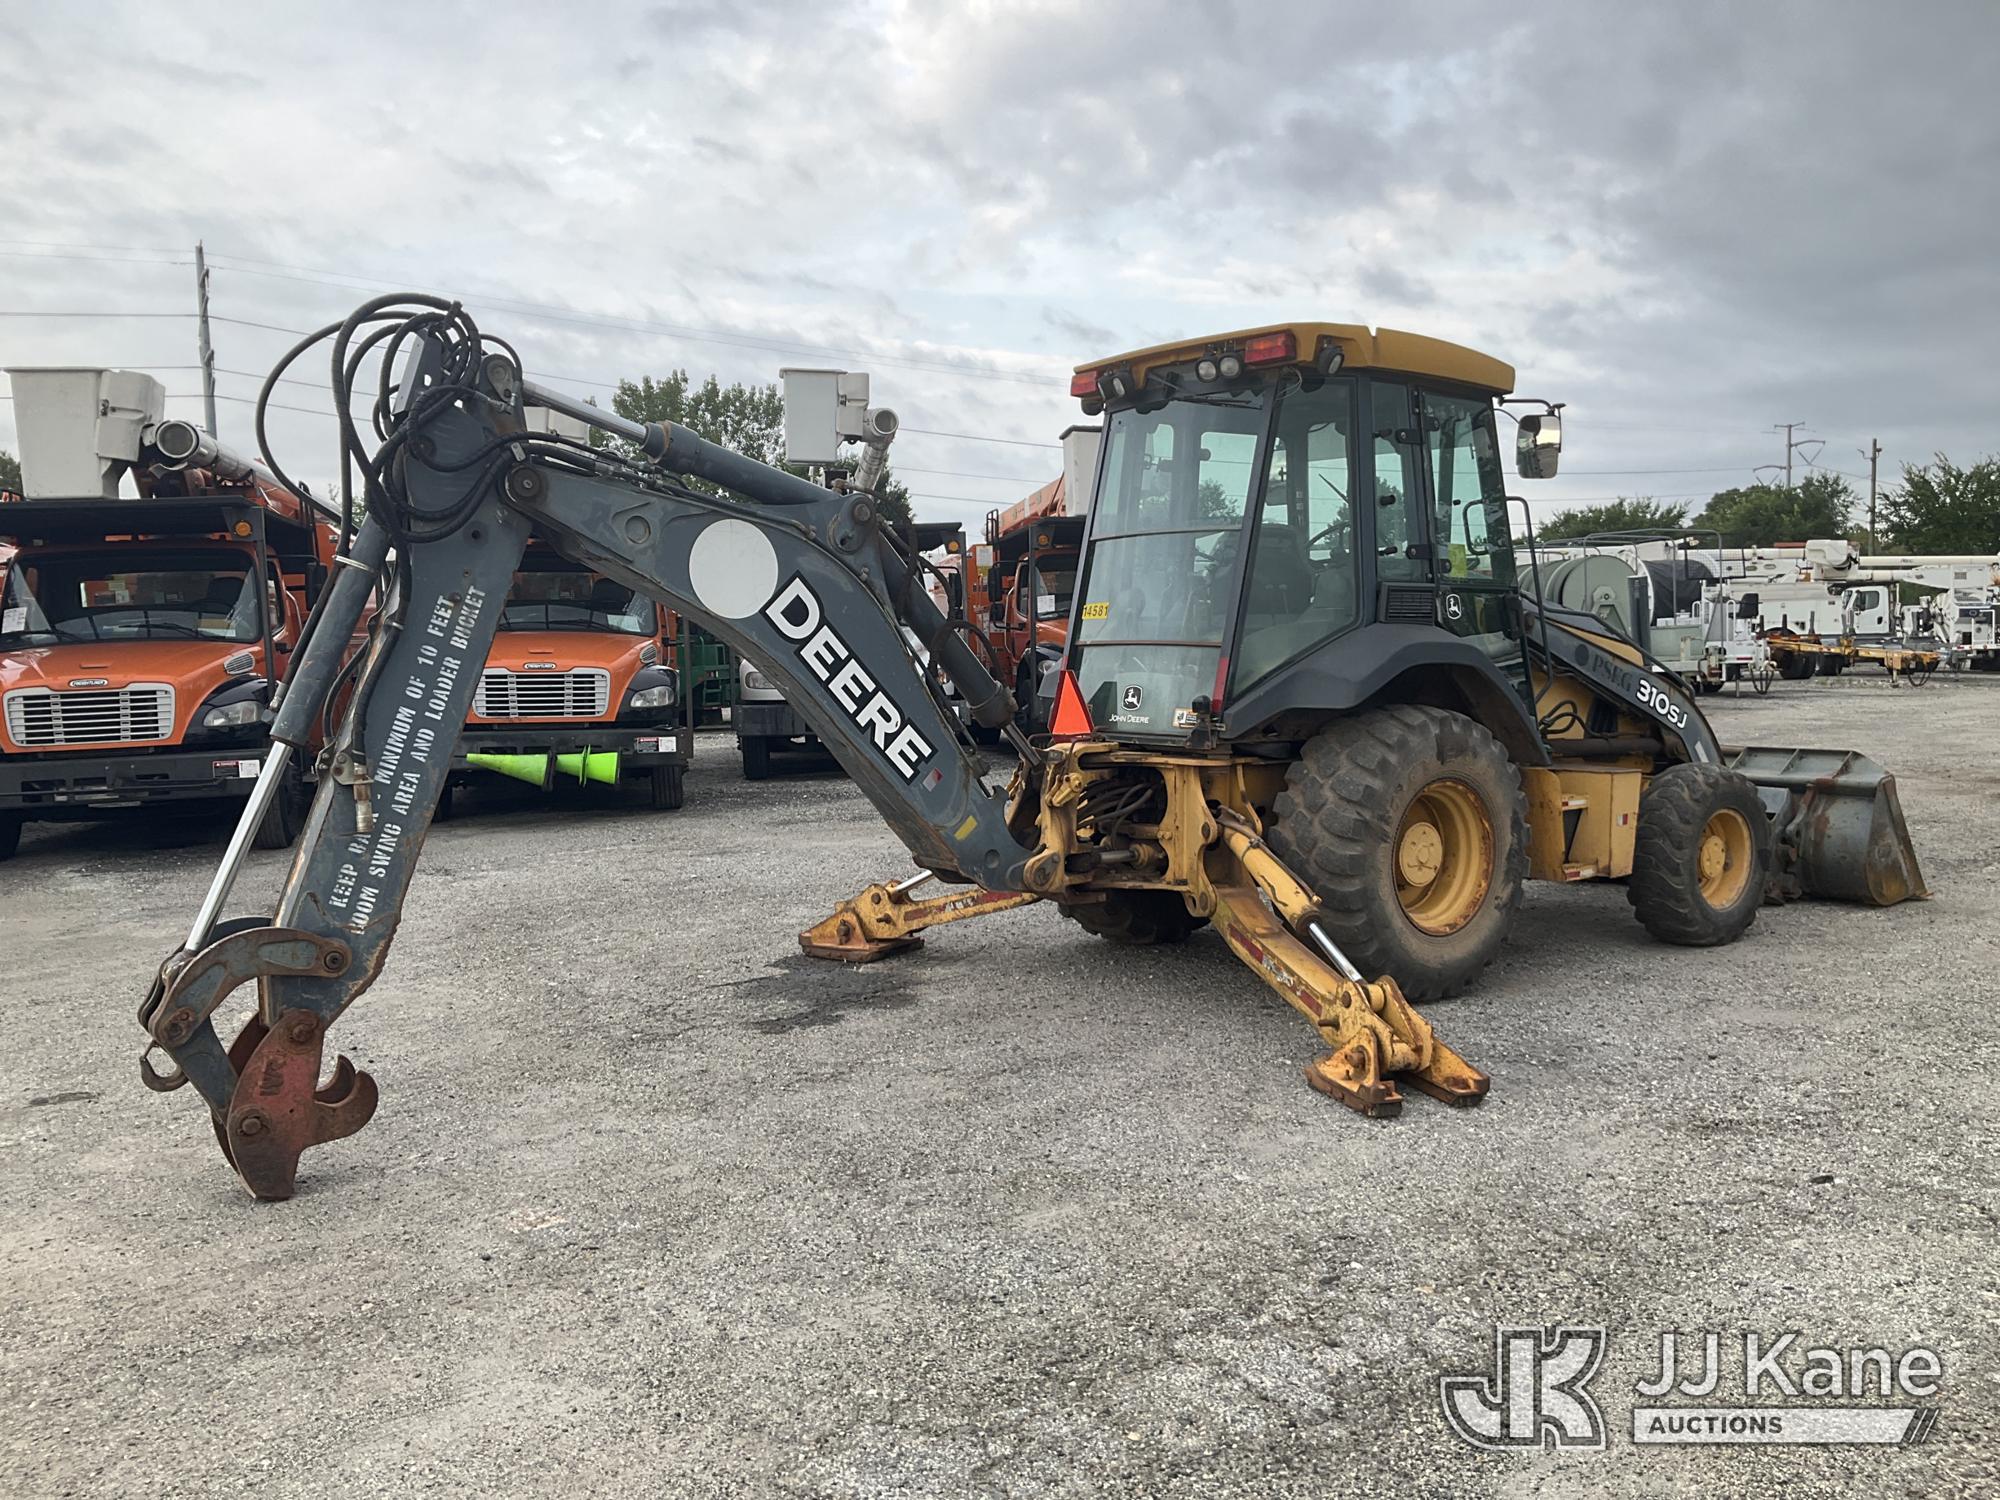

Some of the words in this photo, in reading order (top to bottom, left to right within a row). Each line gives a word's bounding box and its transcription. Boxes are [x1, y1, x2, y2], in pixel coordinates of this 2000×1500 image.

[427, 595, 454, 637] FEET
[1083, 605, 1109, 617] 14581
[417, 644, 439, 666] 10
[1592, 652, 1633, 692] PSEG
[405, 675, 426, 699] OF
[765, 577, 932, 779] DEERE
[1108, 713, 1127, 723] JOHN
[1127, 714, 1150, 724] DEERE
[1636, 679, 1688, 729] 310SJ
[368, 823, 401, 878] SWING
[391, 772, 421, 816] AREA
[410, 728, 435, 763] AND
[425, 656, 461, 721] LOADER
[450, 585, 486, 650] BUCKET
[374, 705, 416, 785] MINIMUM
[329, 863, 358, 908] KEEP
